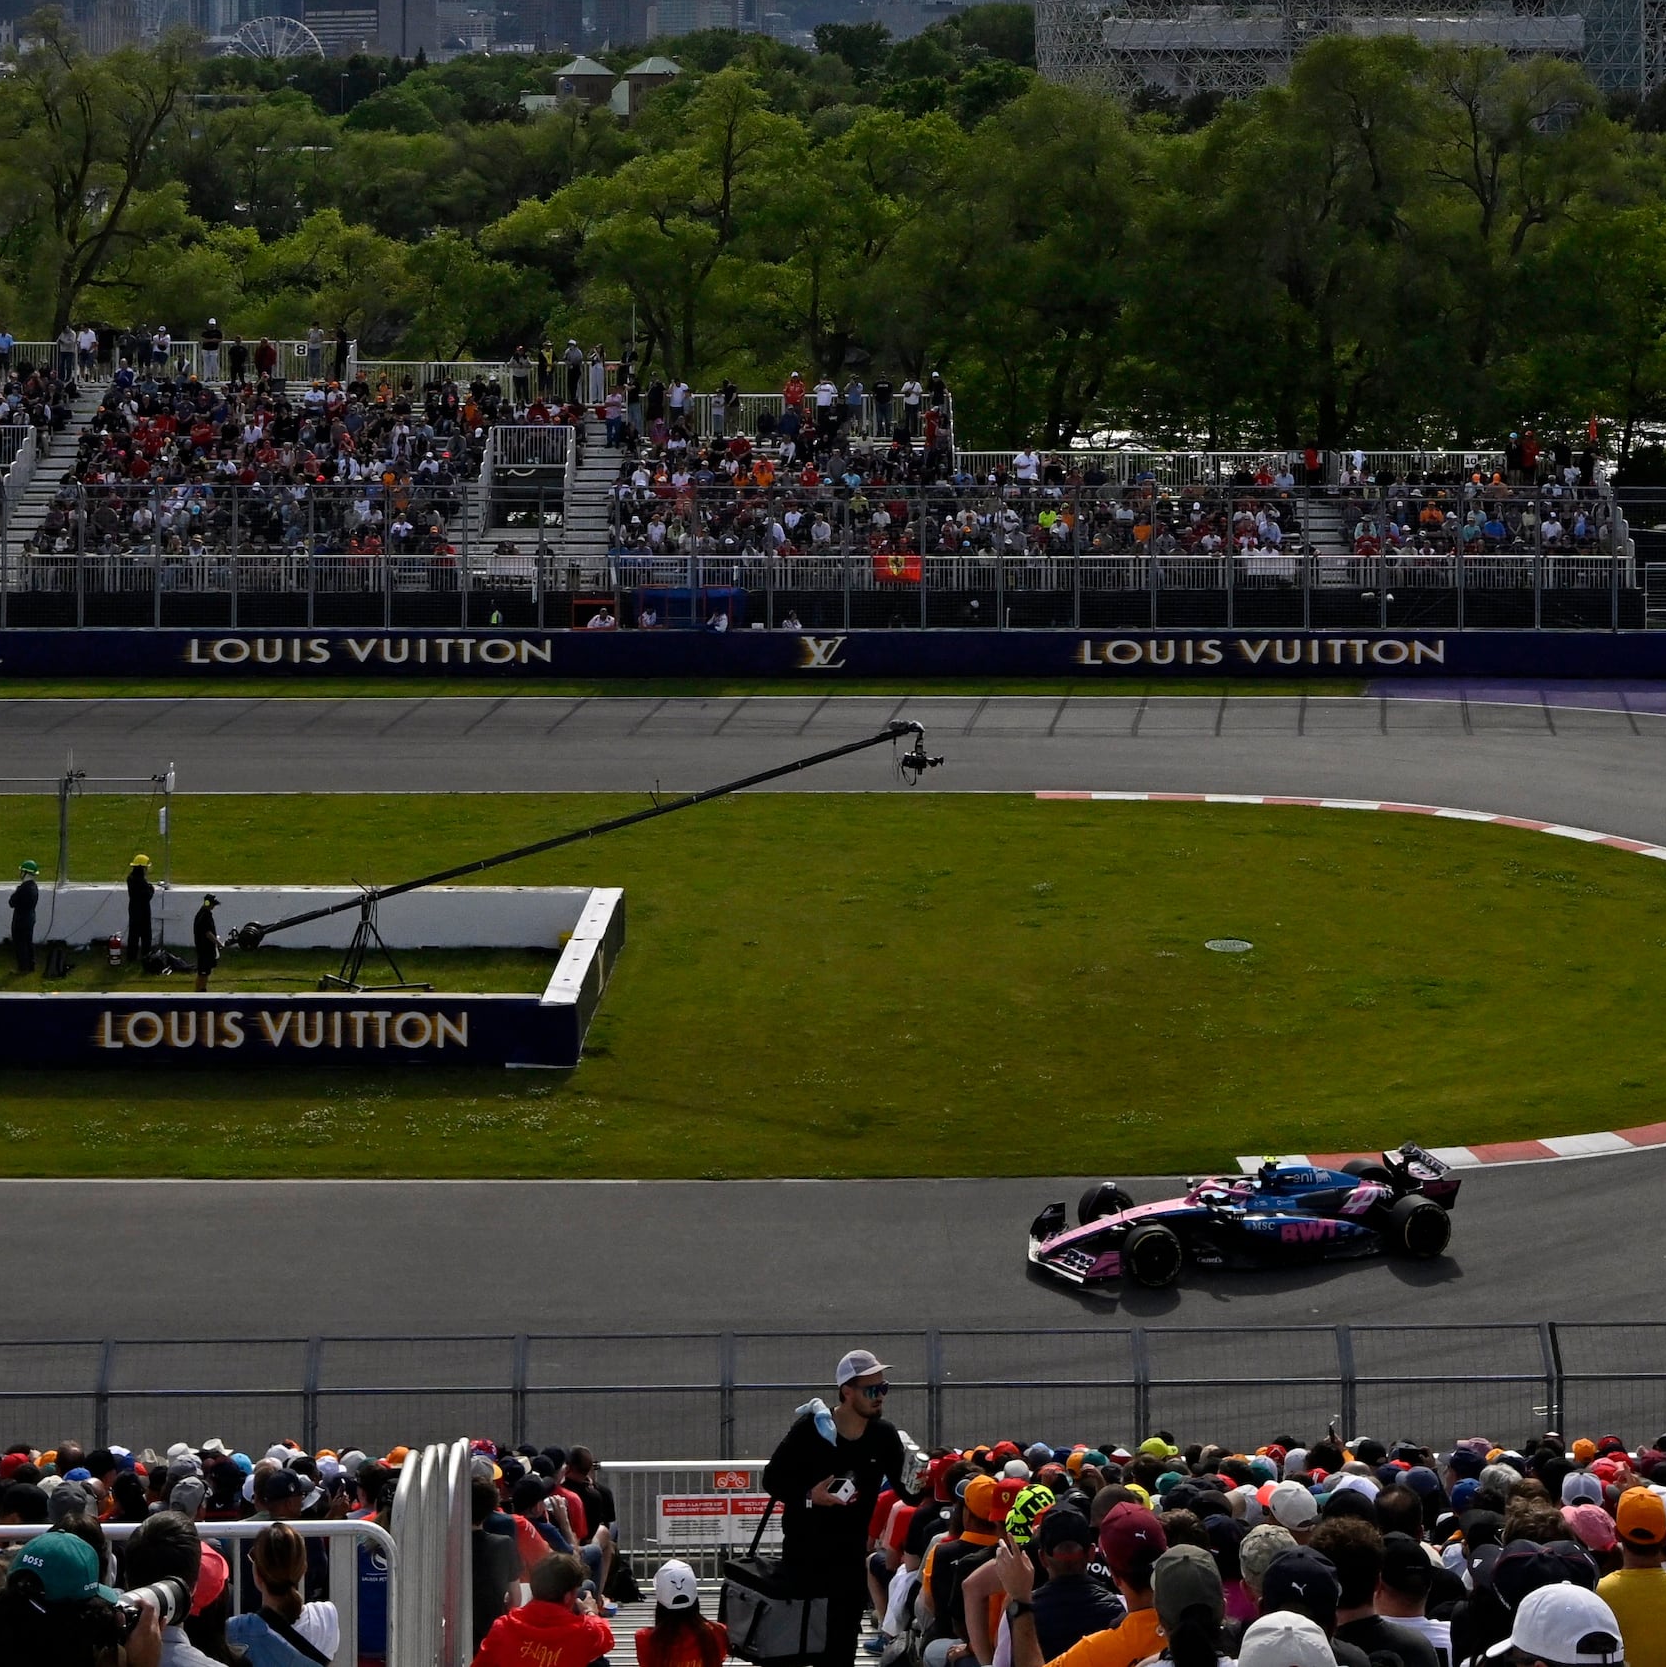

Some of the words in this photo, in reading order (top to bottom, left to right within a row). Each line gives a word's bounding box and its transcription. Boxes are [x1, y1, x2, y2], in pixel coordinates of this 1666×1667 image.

[296, 344, 306, 355] 8
[190, 638, 330, 664] LOUIS
[346, 638, 551, 664] VUITTON
[1082, 639, 1223, 665] LOUIS
[1239, 639, 1444, 665] VUITTON
[100, 1011, 245, 1049] LOUIS
[261, 1011, 468, 1049] VUITTON
[1293, 1172, 1313, 1184] eni
[1252, 1221, 1276, 1231] MSC
[1281, 1218, 1338, 1244] BWT
[22, 1554, 44, 1568] BOSS
